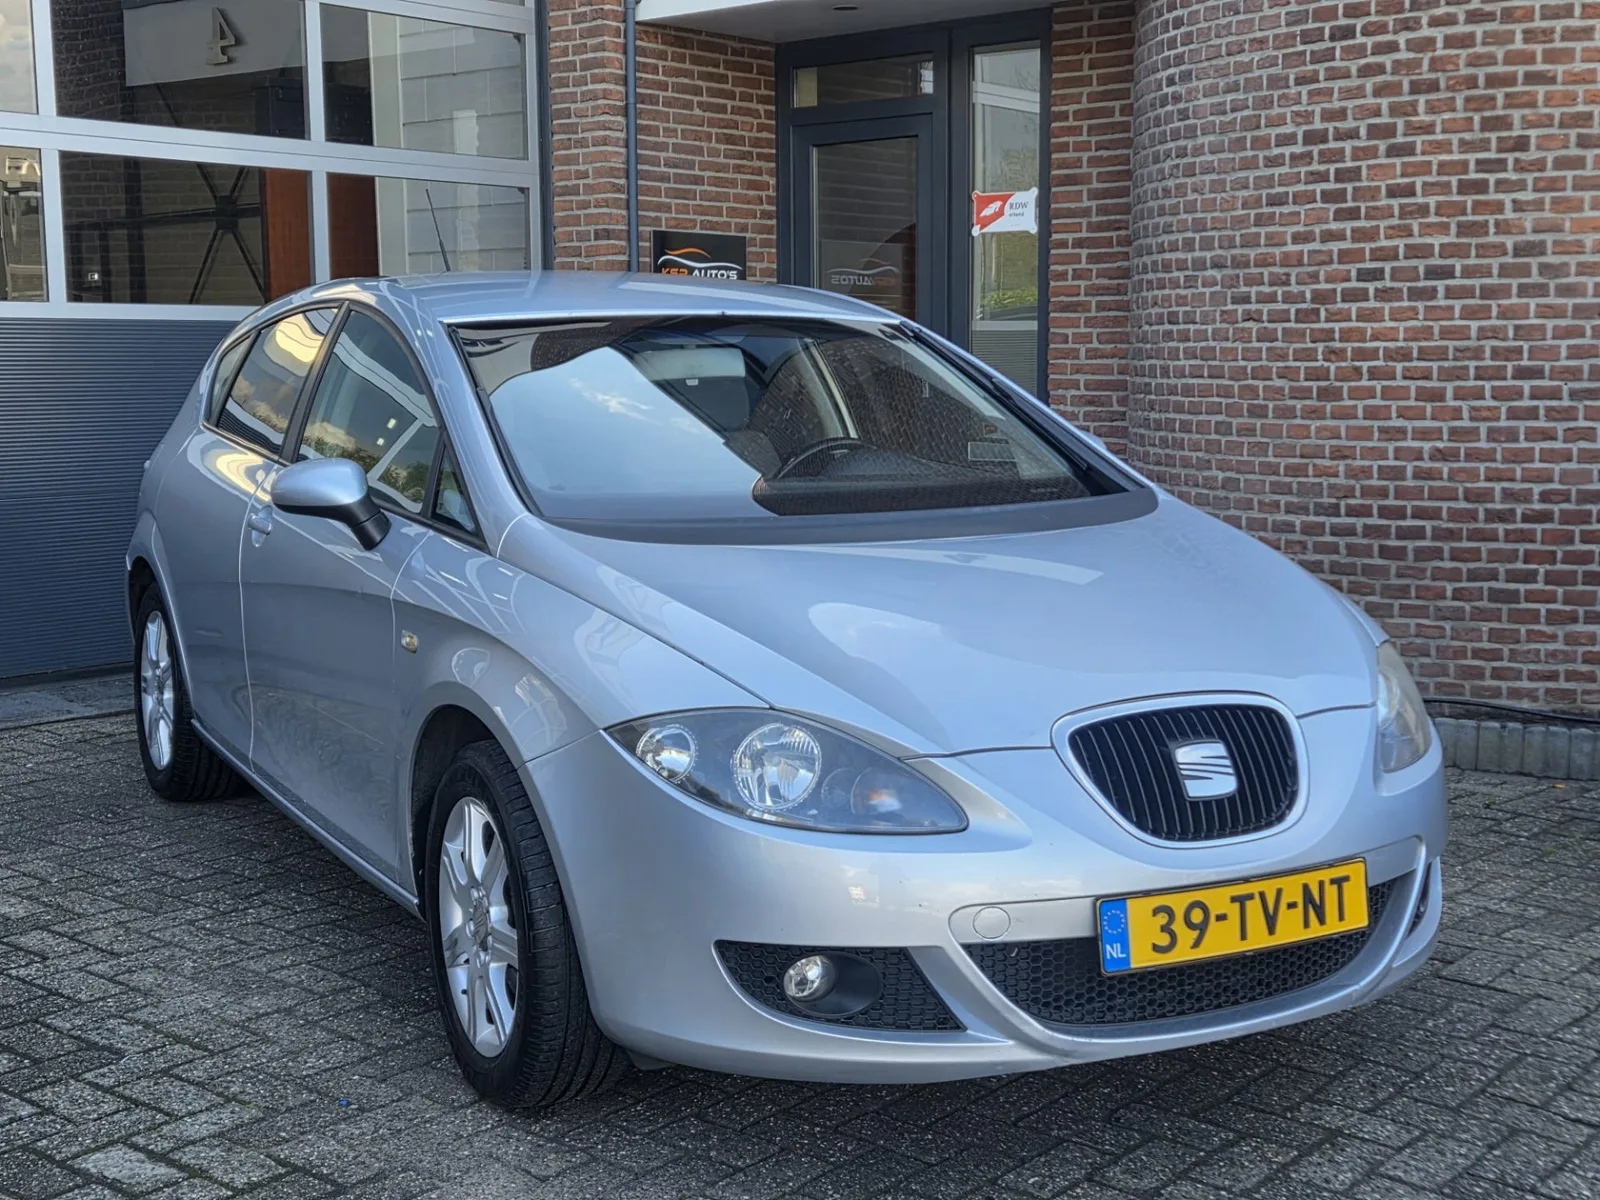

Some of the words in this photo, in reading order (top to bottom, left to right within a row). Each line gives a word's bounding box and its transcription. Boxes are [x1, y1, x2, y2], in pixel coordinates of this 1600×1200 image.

[1009, 201, 1028, 210] RDW
[1151, 874, 1351, 954] 39-TV-NT
[1105, 942, 1127, 960] NL
